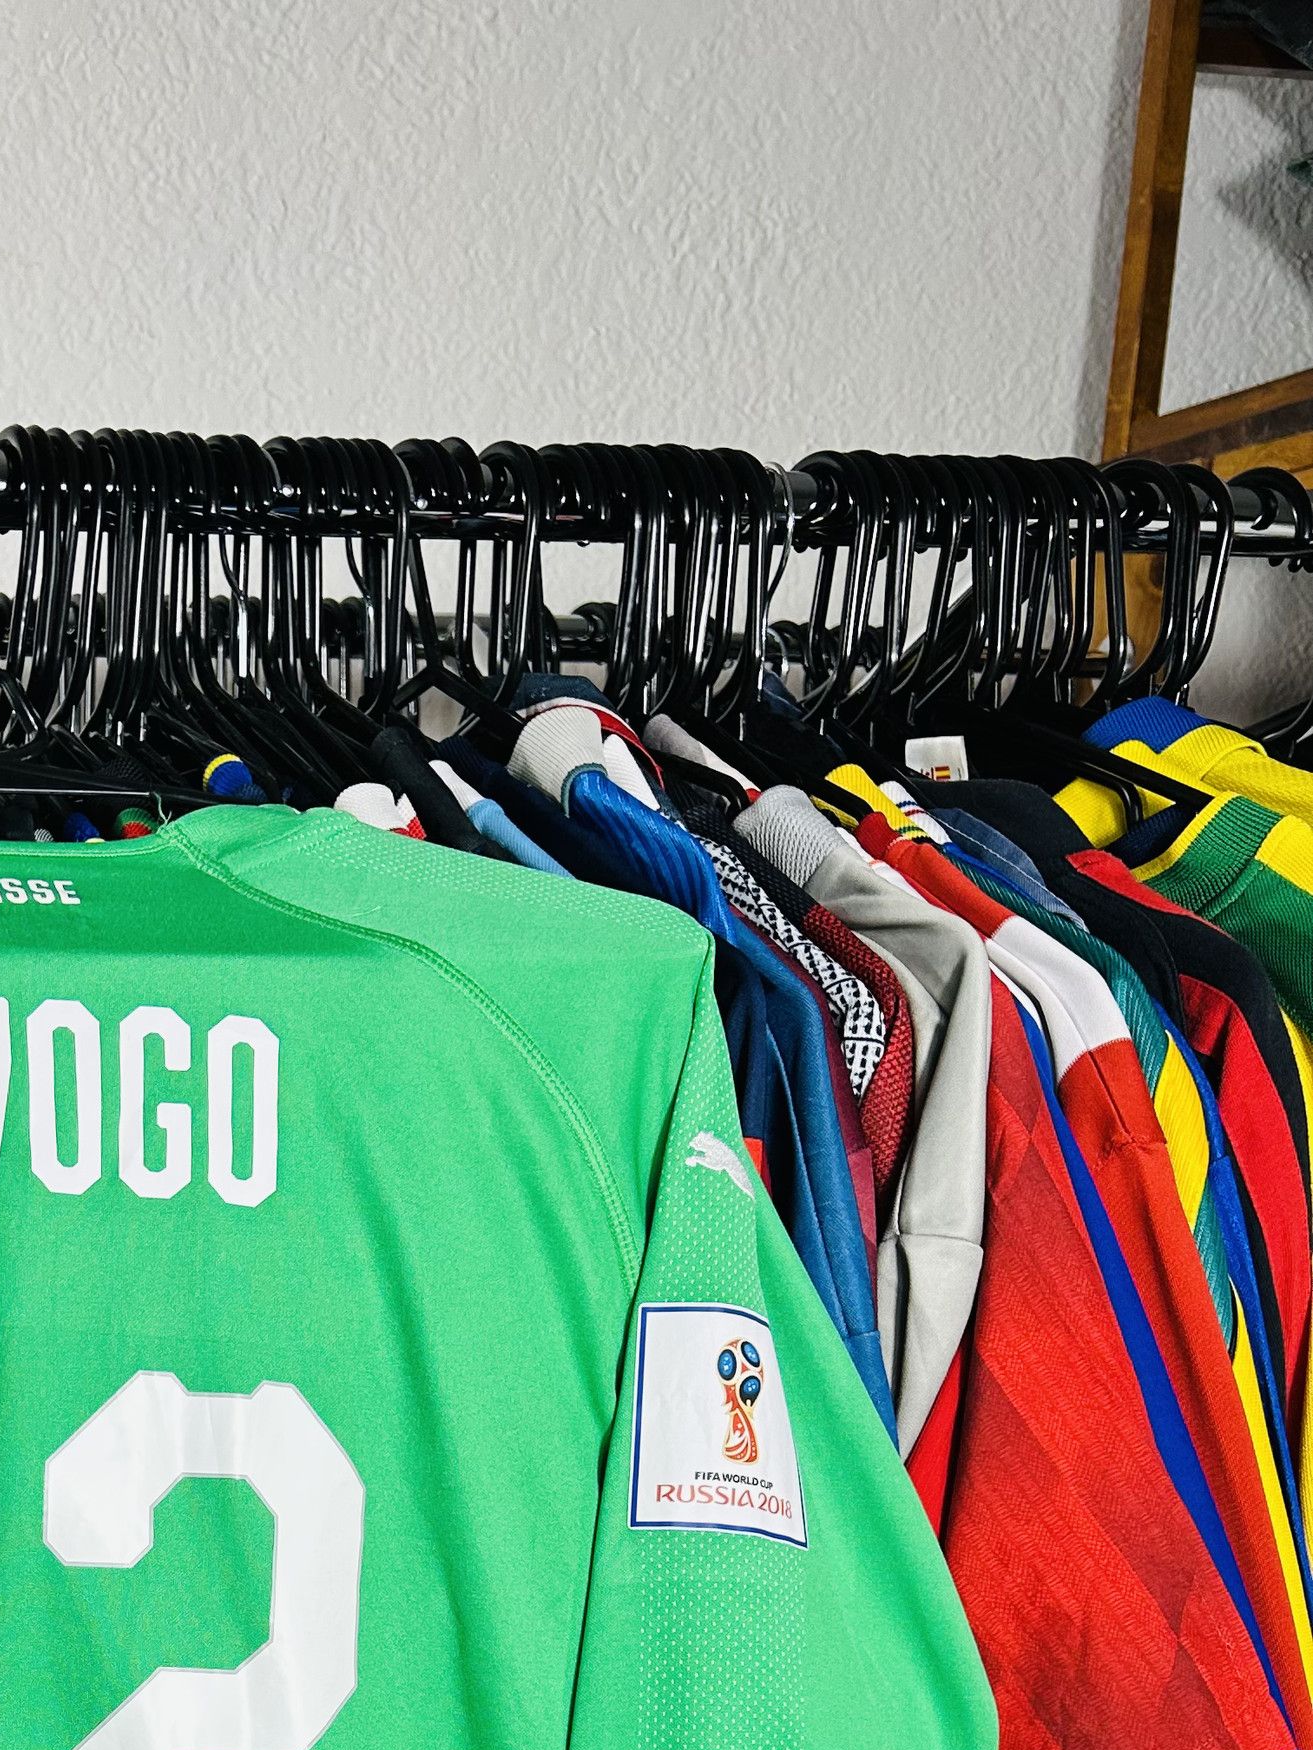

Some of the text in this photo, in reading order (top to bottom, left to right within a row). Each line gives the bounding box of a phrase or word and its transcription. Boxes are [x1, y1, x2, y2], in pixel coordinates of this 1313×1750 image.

[694, 1471, 774, 1491] FIFA WORLD CUP
[656, 1484, 793, 1520] RUSSIA 2018
